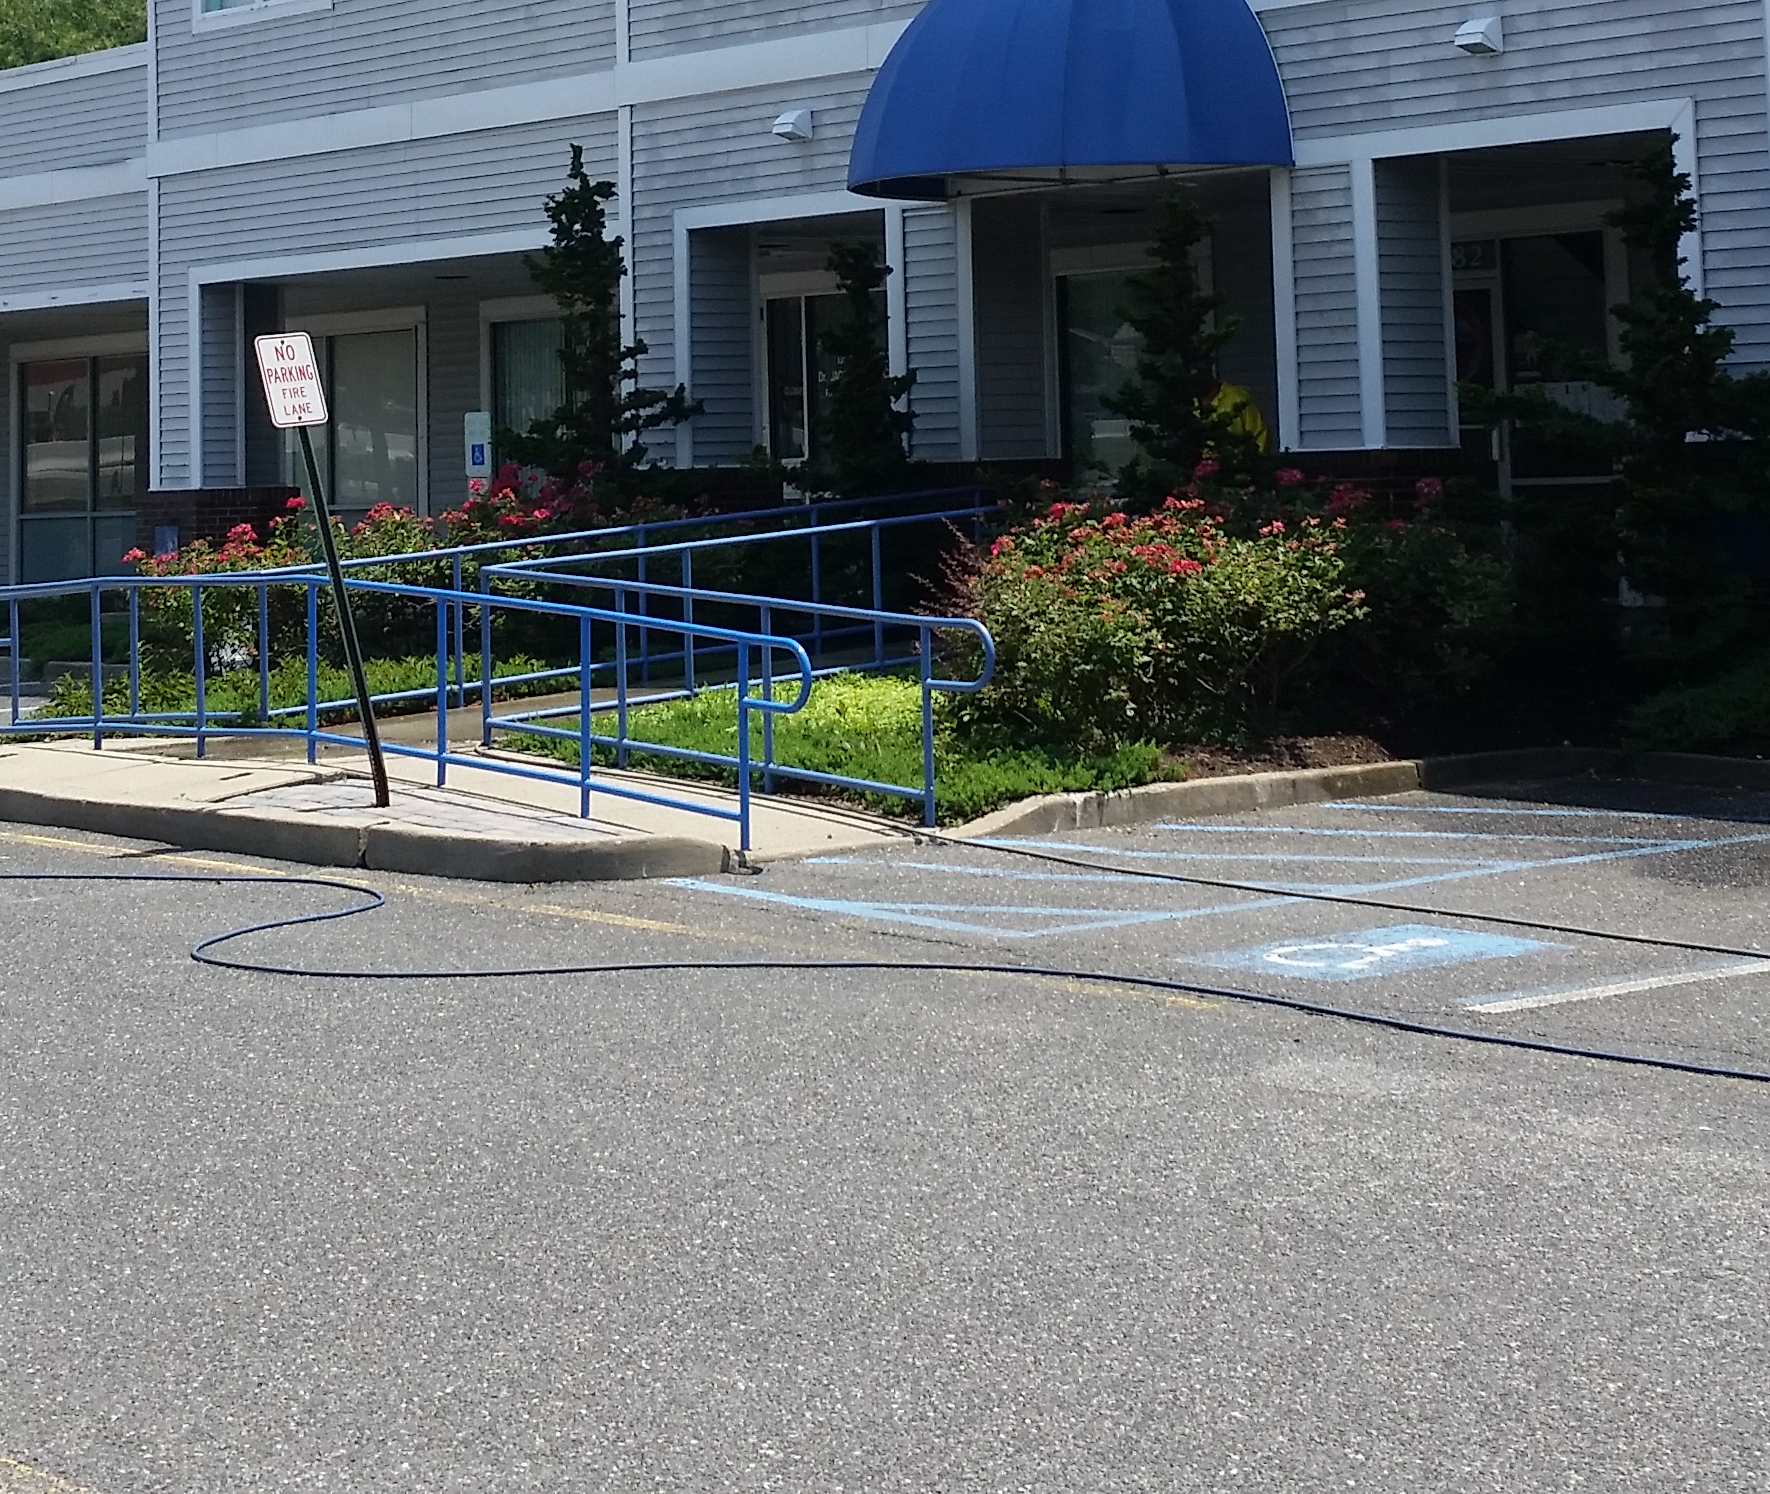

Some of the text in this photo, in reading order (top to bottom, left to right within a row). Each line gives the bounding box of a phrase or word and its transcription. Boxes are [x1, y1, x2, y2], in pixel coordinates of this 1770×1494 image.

[274, 345, 295, 361] NO
[267, 364, 314, 384] PARKING
[282, 386, 307, 399] FIRE
[284, 403, 313, 415] LANE
